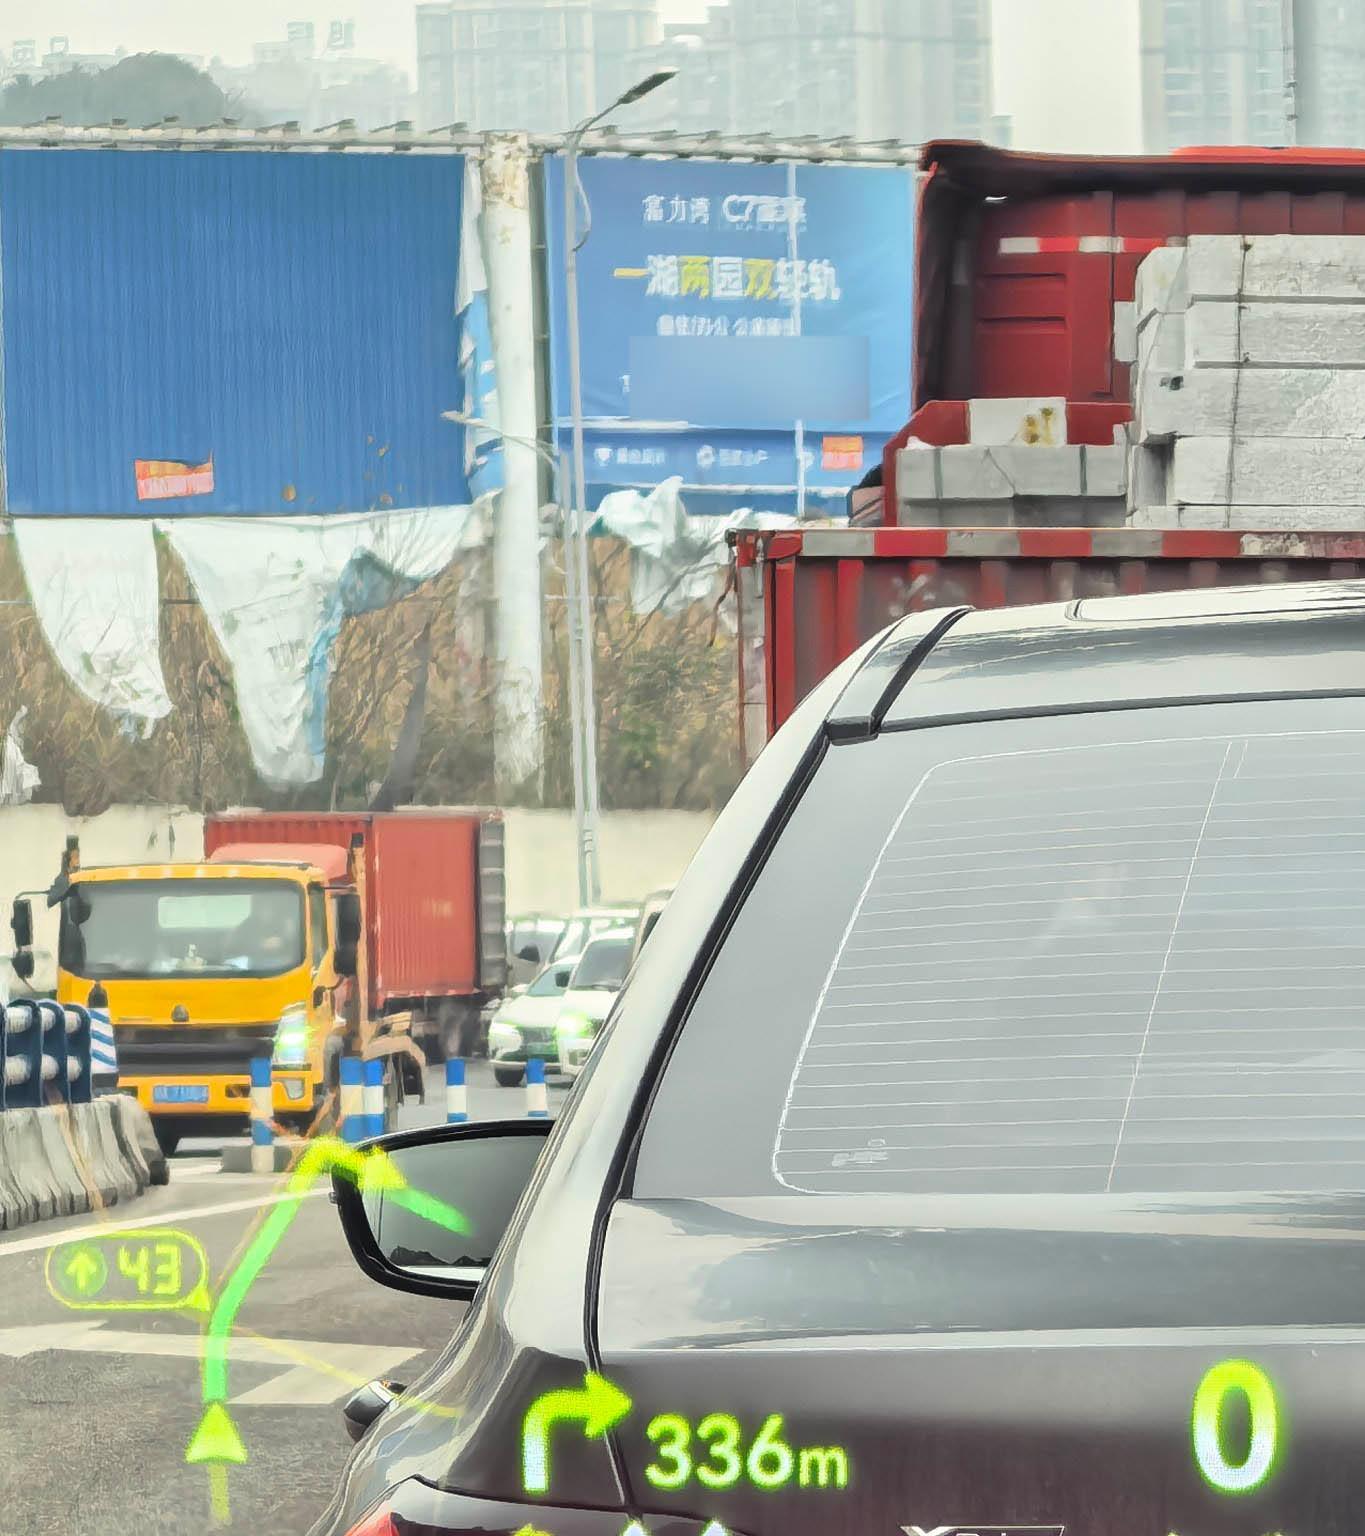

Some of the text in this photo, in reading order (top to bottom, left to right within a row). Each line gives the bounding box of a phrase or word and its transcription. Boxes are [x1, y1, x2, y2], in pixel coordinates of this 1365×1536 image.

[117, 1244, 182, 1296] 43
[644, 1412, 848, 1491] 336m
[1191, 1357, 1279, 1494] 0
